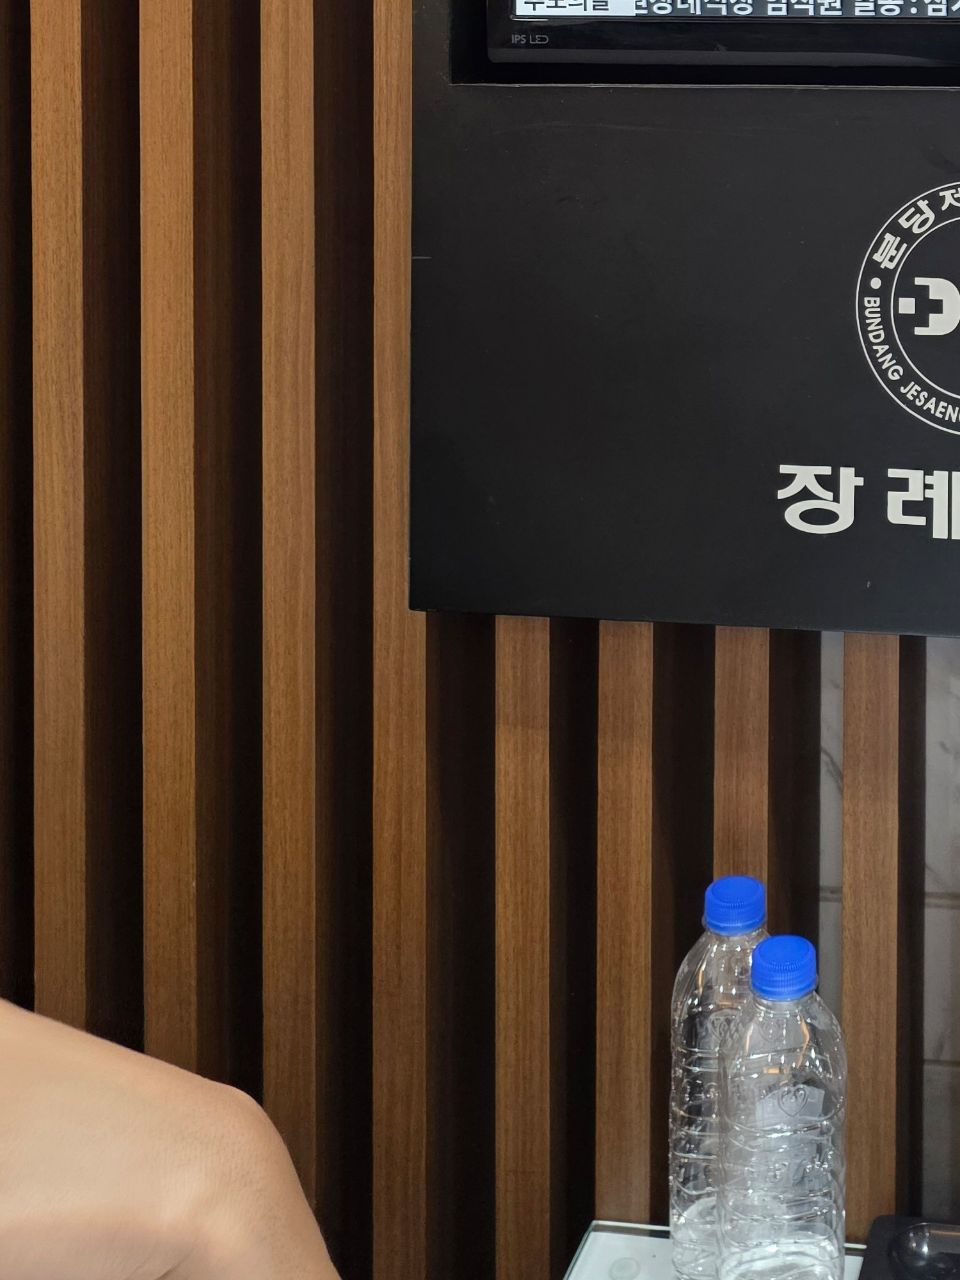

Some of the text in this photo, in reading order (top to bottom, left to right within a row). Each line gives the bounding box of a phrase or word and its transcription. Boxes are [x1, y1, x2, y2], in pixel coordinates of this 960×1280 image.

[511, 34, 549, 44] IPS LED
[863, 296, 904, 381] BUNDANG
